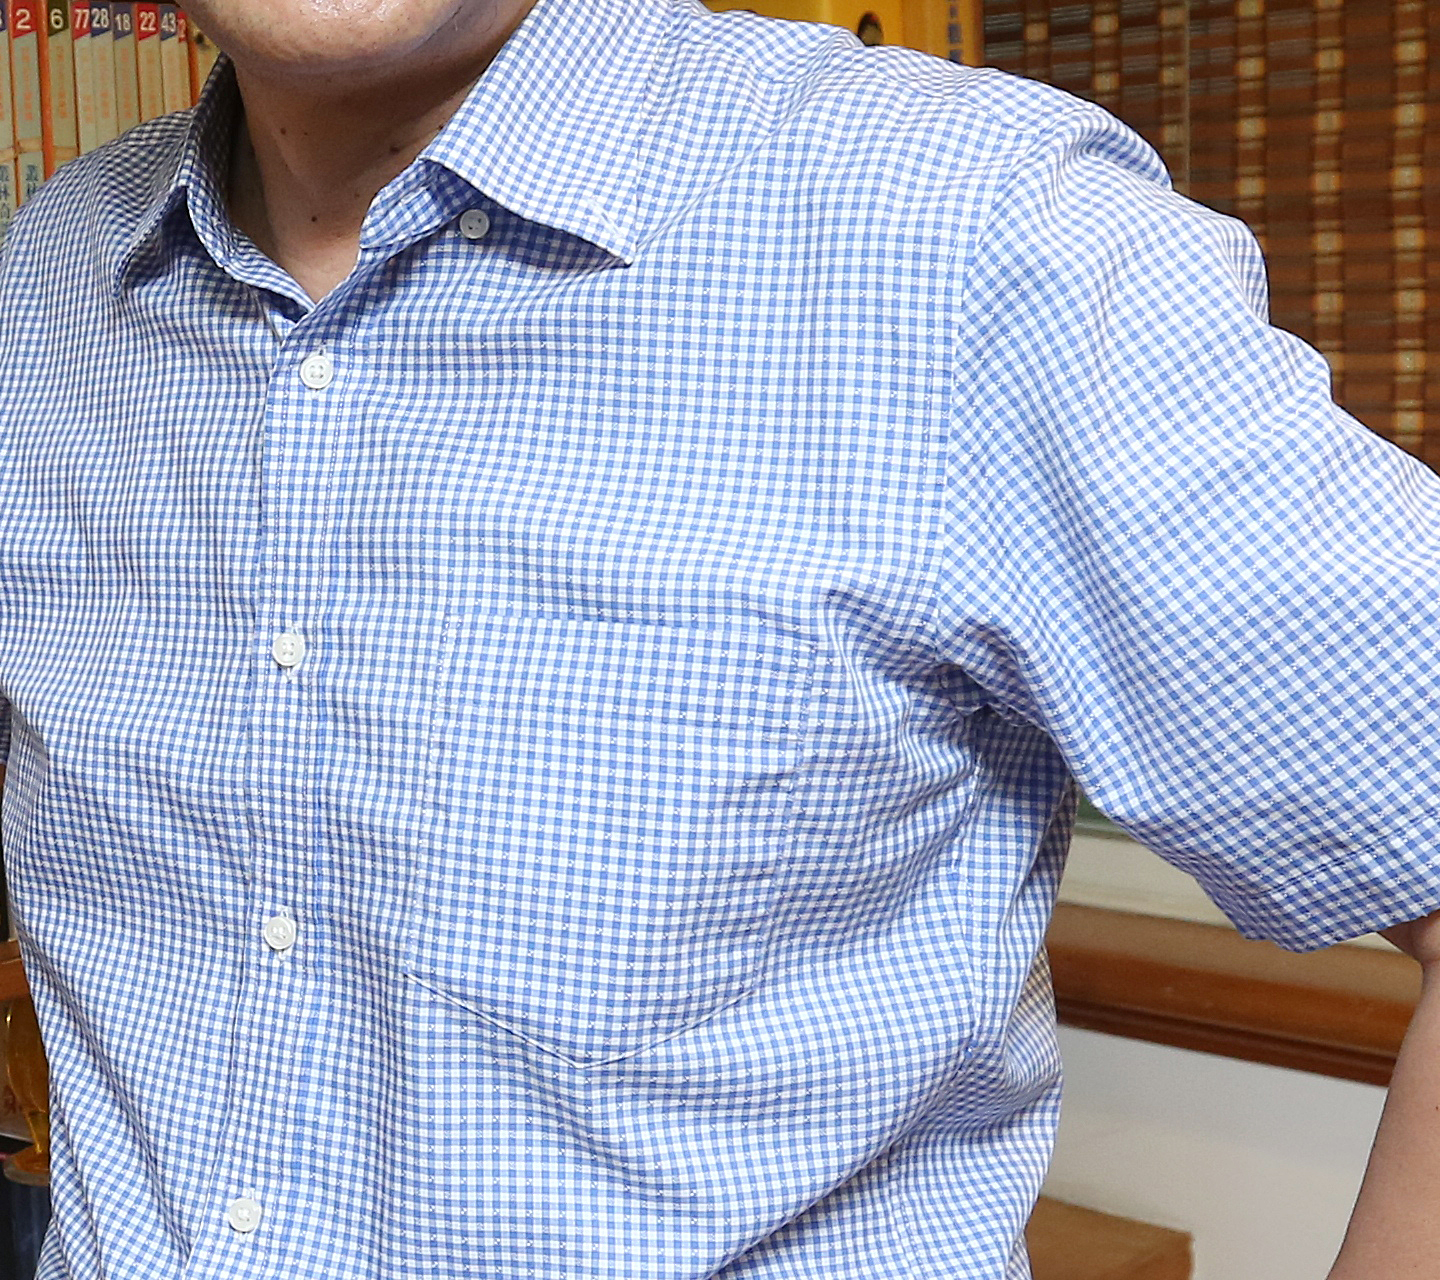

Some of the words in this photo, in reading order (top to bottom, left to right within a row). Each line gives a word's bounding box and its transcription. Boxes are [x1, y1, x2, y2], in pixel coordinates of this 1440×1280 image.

[14, 7, 33, 31] 2
[48, 6, 65, 30] 6
[73, 6, 91, 30] 77
[90, 6, 111, 29] 28
[114, 12, 133, 32] 18
[138, 10, 158, 32] 22
[160, 10, 177, 33] 43
